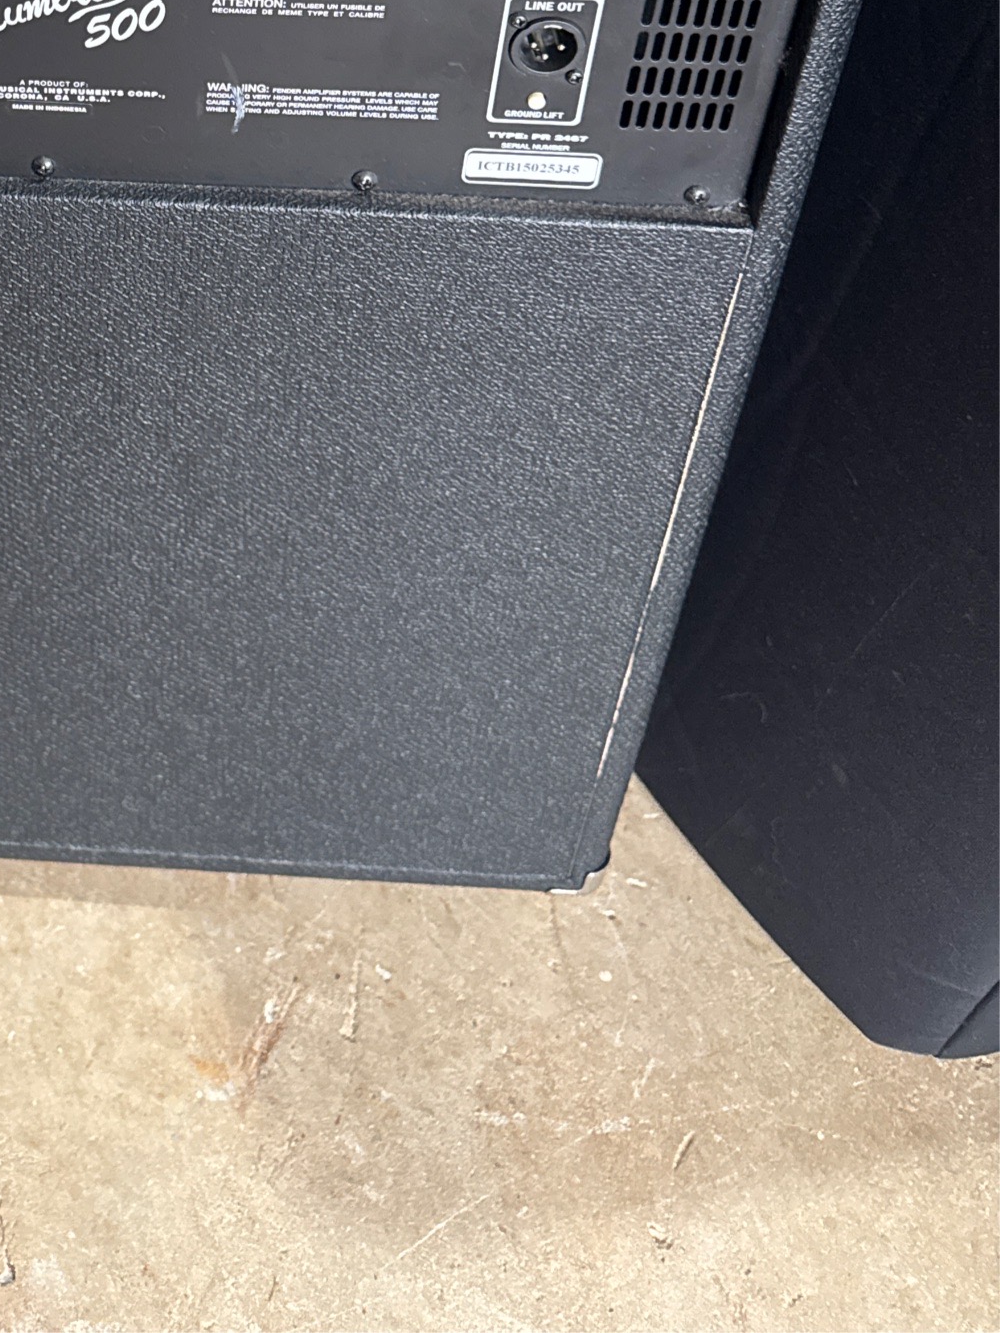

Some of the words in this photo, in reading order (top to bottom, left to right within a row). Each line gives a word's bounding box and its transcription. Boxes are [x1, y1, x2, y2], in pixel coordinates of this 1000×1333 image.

[290, 2, 325, 10] UTILISER
[524, 1, 554, 11] LINE
[557, 2, 585, 12] OUT
[212, 7, 257, 15] RECHANGE
[28, 79, 71, 87] PRODUCT
[43, 87, 124, 96] INSTRUMENTS
[127, 90, 166, 98] CORP.,
[77, 94, 111, 102] U.S.A.
[504, 110, 542, 118] GROUND
[543, 111, 565, 119] LIFT
[488, 131, 529, 140] TYPE:
[531, 133, 551, 141] PR
[500, 142, 531, 150] SERIAL
[532, 143, 570, 151] NUMBER
